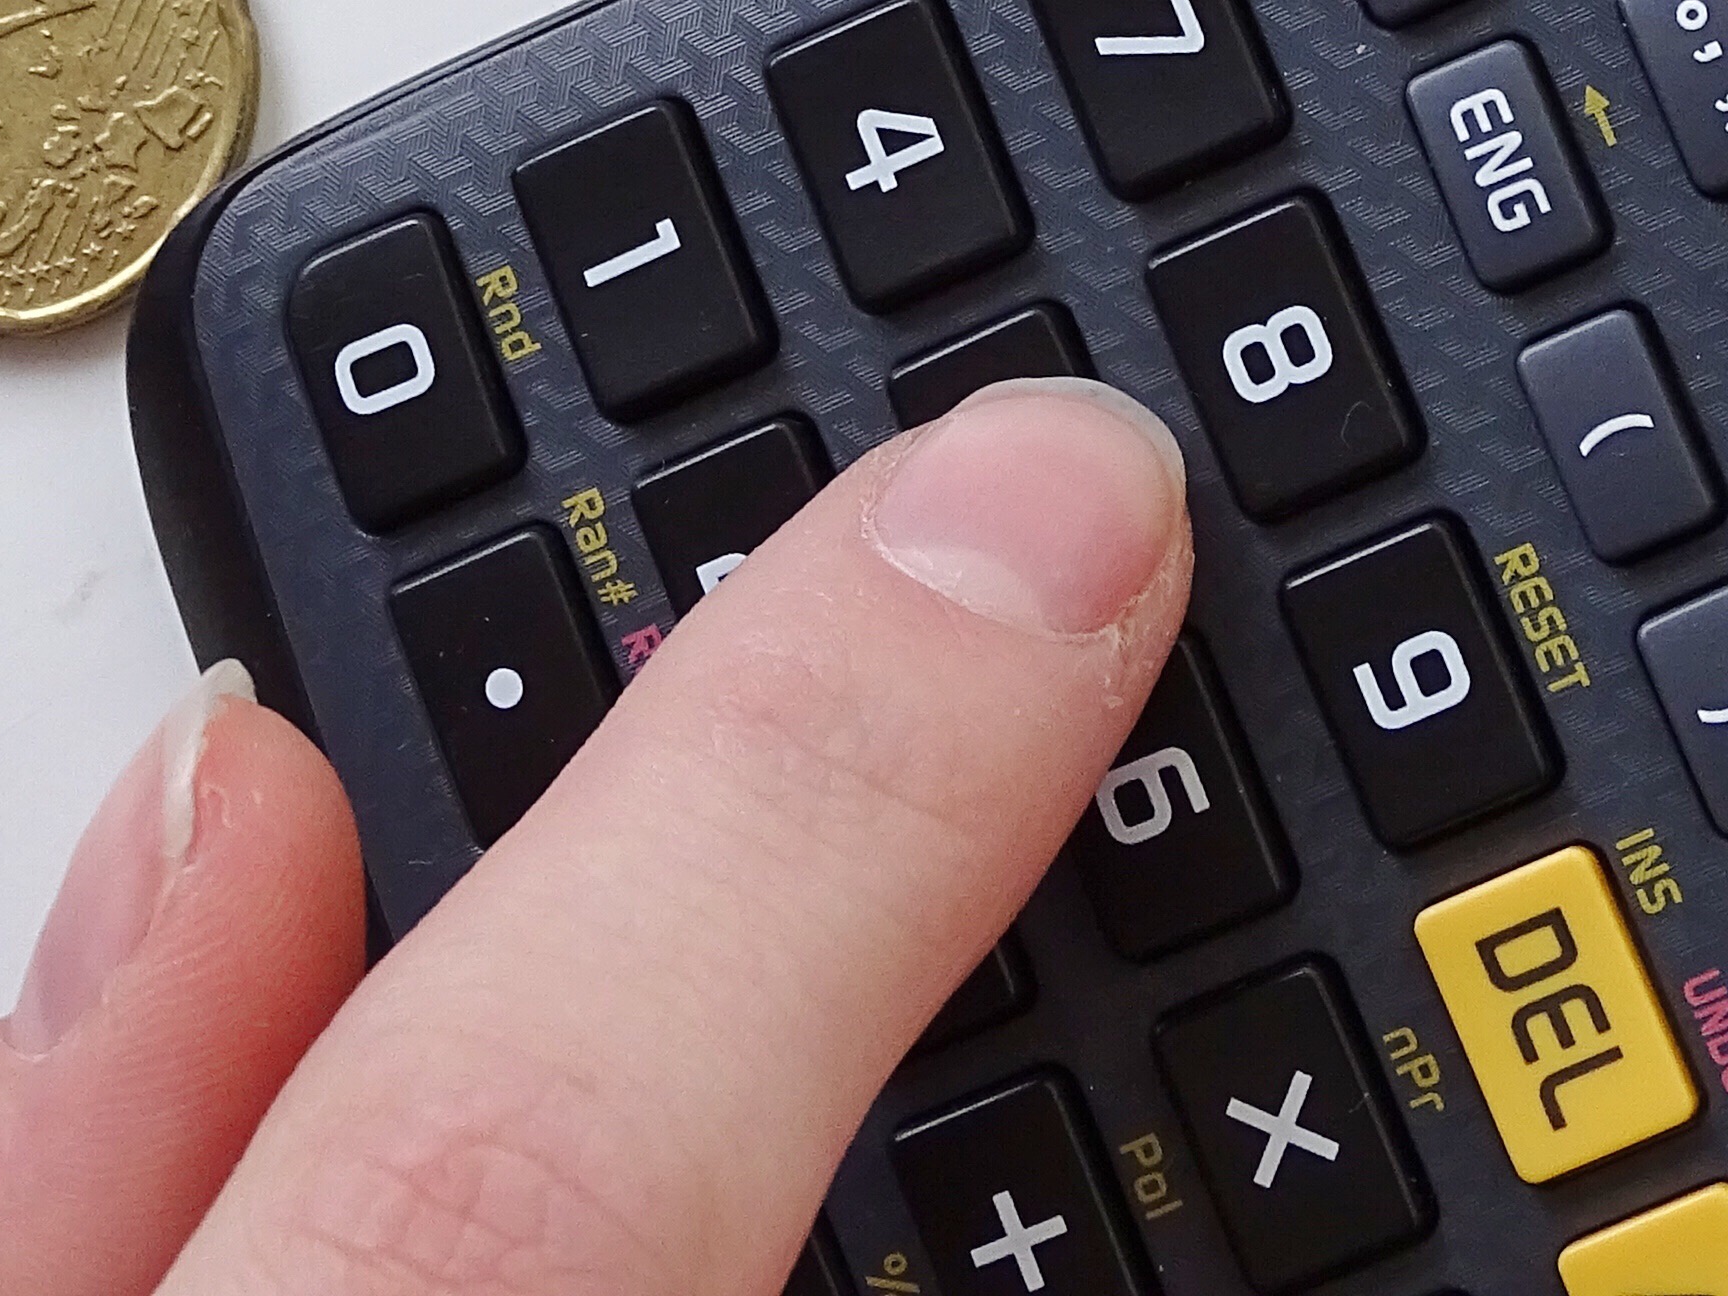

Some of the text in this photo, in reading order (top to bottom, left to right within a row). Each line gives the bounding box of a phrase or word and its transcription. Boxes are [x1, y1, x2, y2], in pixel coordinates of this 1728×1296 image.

[844, 108, 946, 193] 4
[1448, 87, 1553, 233] ENG
[582, 216, 682, 288] 1
[475, 264, 542, 364] Rnd
[1222, 305, 1334, 404] 8
[334, 323, 436, 415] 0
[560, 487, 641, 608] Ran#
[1493, 541, 1591, 694] RESET
[1352, 629, 1471, 731] 9
[1095, 745, 1211, 846] 6
[1614, 826, 1684, 917] INS
[1473, 906, 1625, 1132] DEL
[1381, 1025, 1446, 1114] nPr
[1118, 1130, 1184, 1222] Pol
